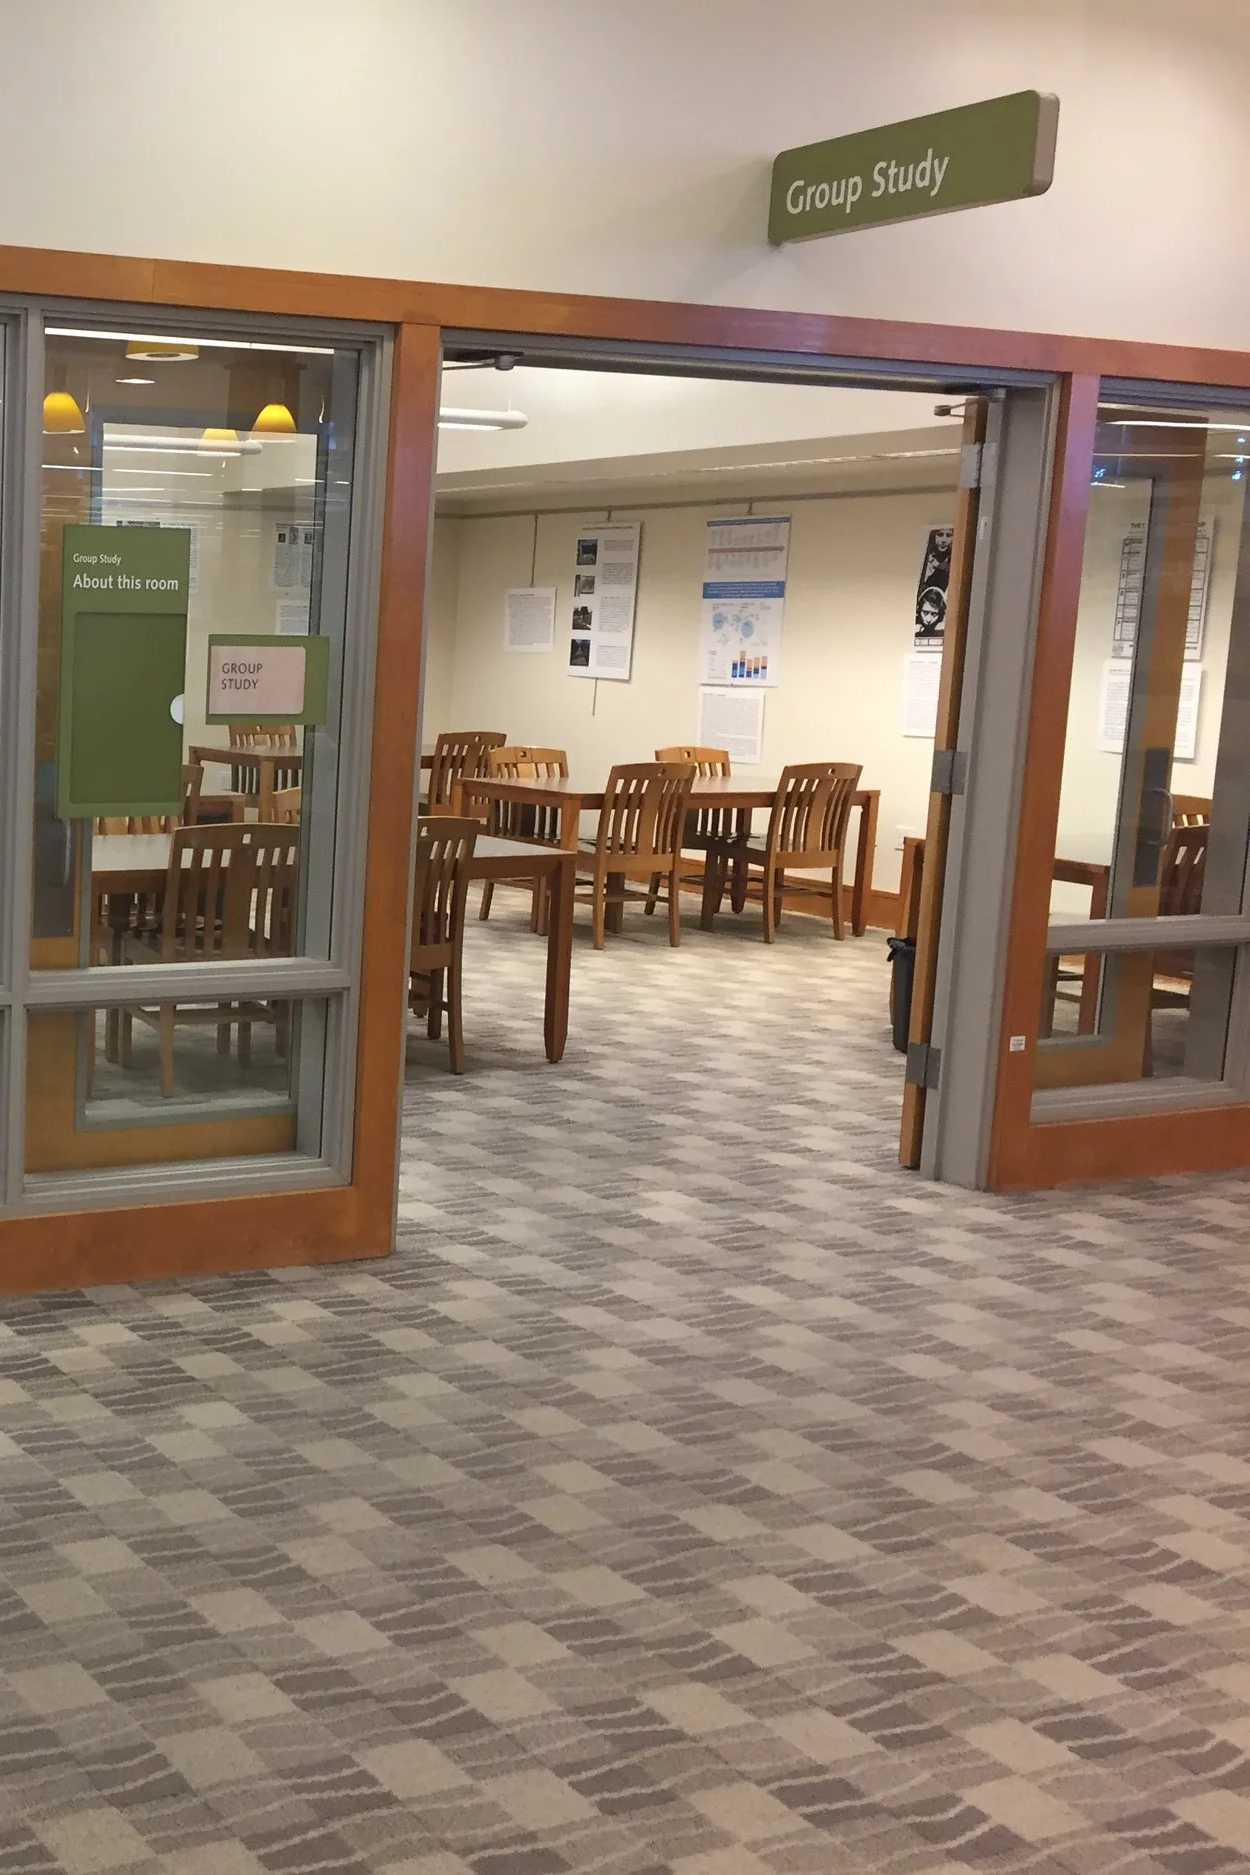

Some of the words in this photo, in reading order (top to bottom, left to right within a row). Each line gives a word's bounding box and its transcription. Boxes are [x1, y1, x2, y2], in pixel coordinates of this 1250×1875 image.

[786, 175, 862, 214] Group
[871, 147, 949, 197] Study
[73, 553, 98, 564] Group
[99, 553, 121, 566] Study
[72, 573, 114, 589] About
[117, 574, 141, 589] this
[145, 578, 179, 590] room
[221, 662, 263, 674] GROUP
[221, 678, 259, 690] STUDY
